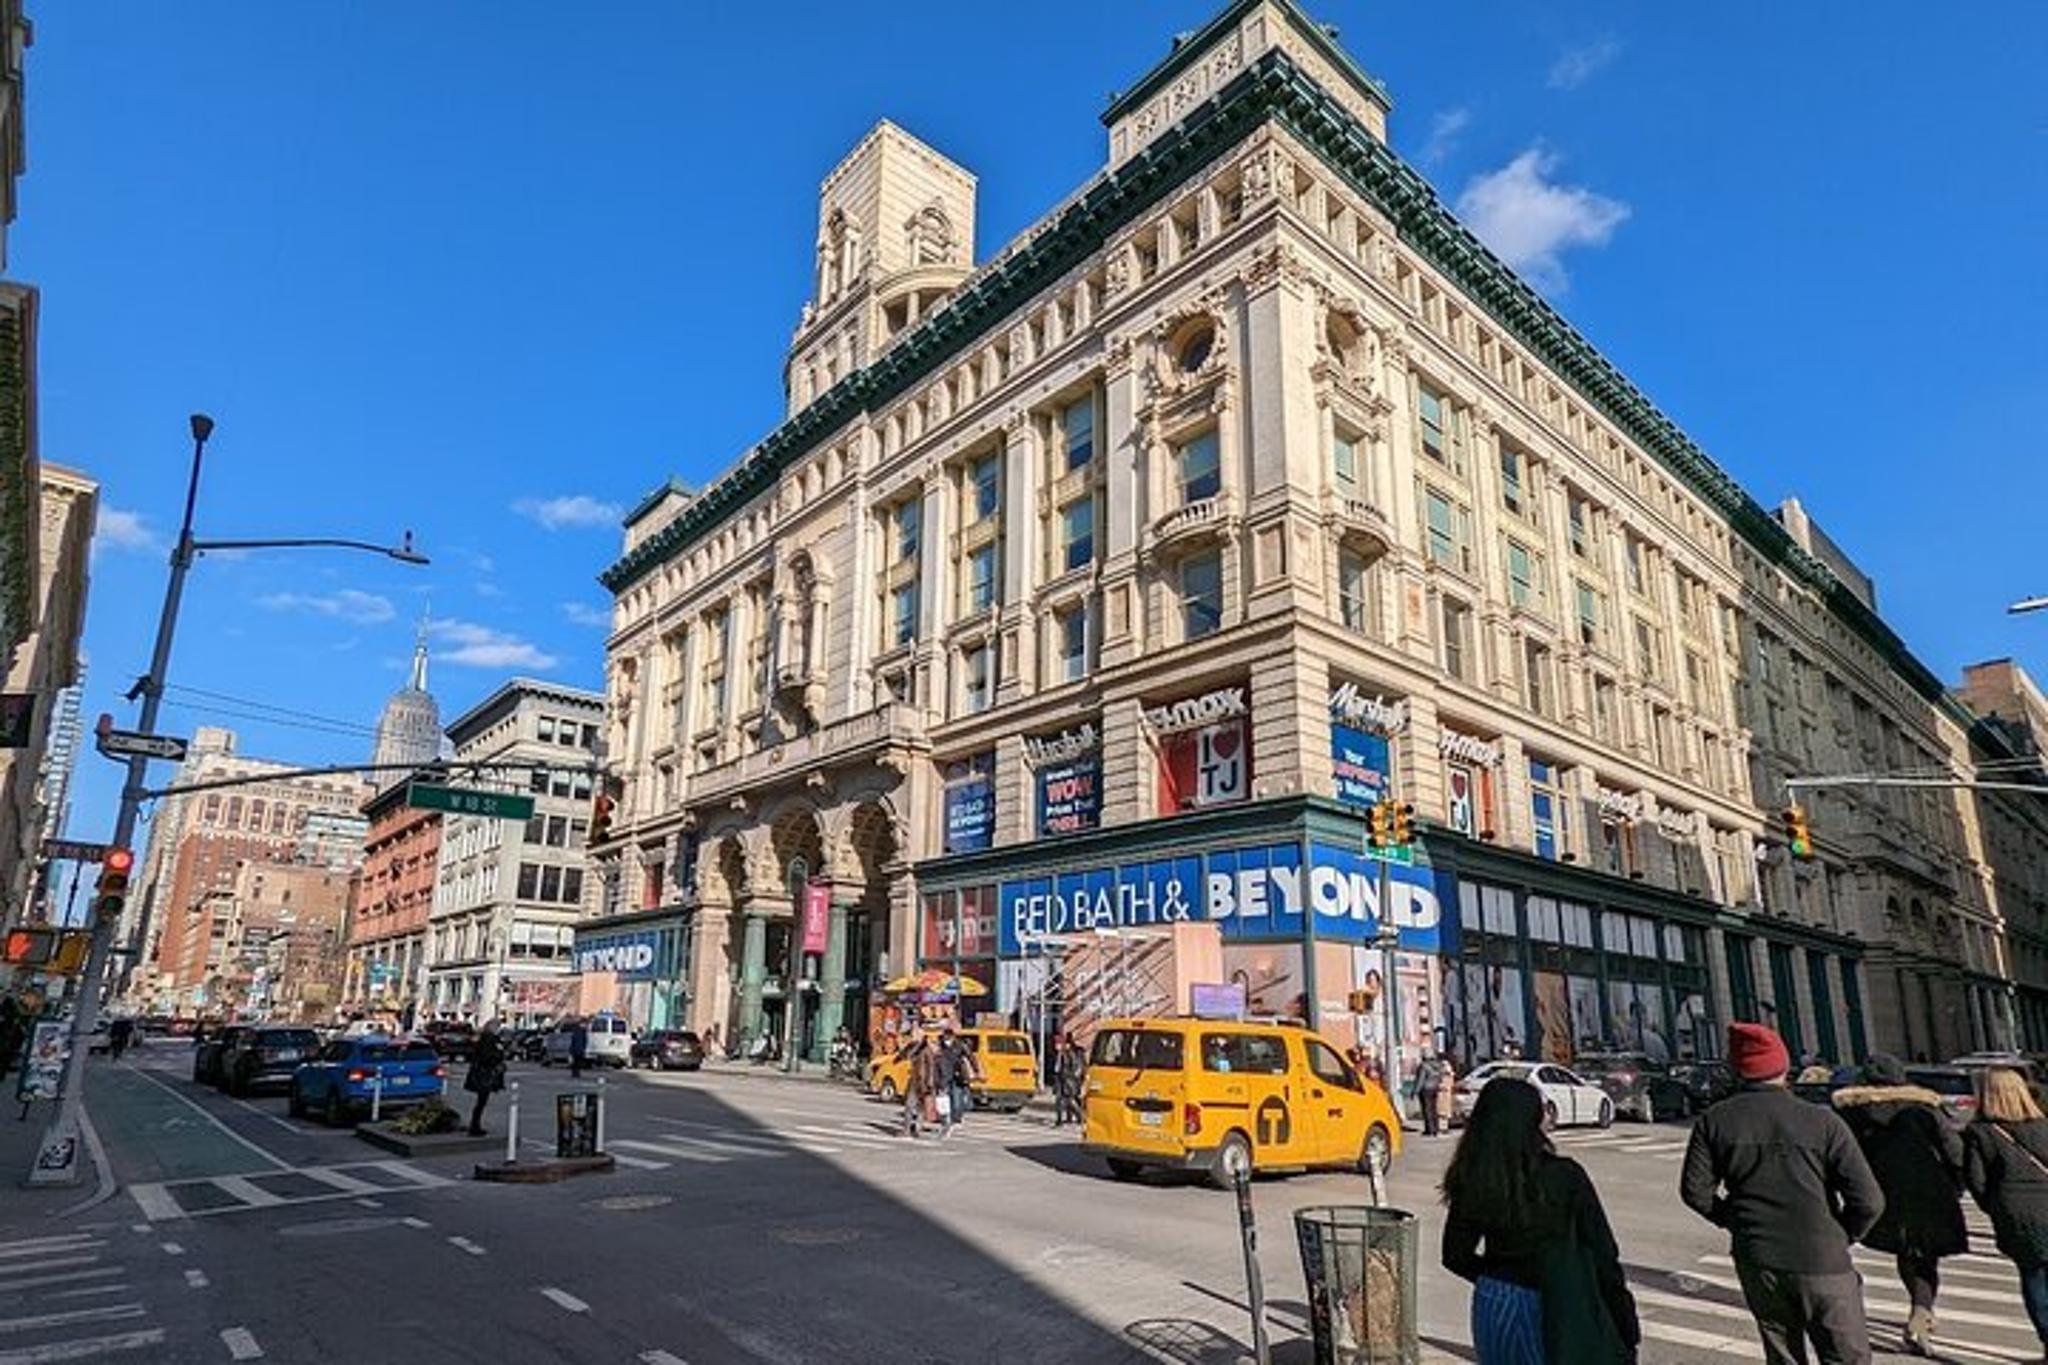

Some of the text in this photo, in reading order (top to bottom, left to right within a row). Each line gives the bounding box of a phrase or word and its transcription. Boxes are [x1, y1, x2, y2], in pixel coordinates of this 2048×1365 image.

[1200, 760, 1238, 796] TJ
[1015, 894, 1067, 940] BED
[1073, 879, 1156, 931] BATH
[1163, 878, 1190, 922] &
[1208, 865, 1441, 929] BEYOND
[581, 944, 653, 972] BEYOND
